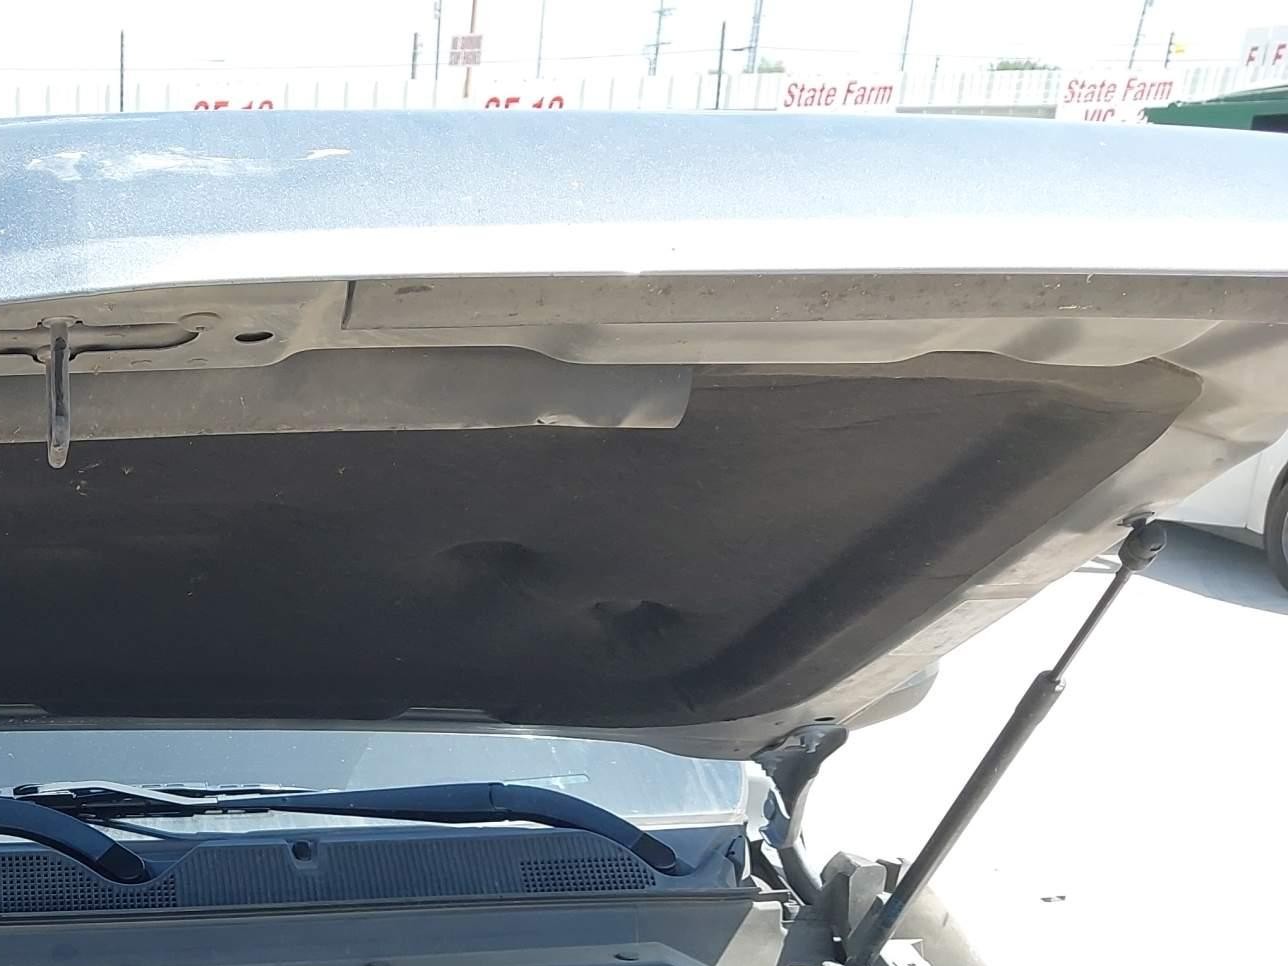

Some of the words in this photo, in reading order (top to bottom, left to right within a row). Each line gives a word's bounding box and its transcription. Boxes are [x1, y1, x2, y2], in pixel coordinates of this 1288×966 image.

[784, 82, 837, 108] State
[842, 80, 894, 105] Farm
[1064, 79, 1117, 104] State
[1122, 77, 1174, 102] Farm
